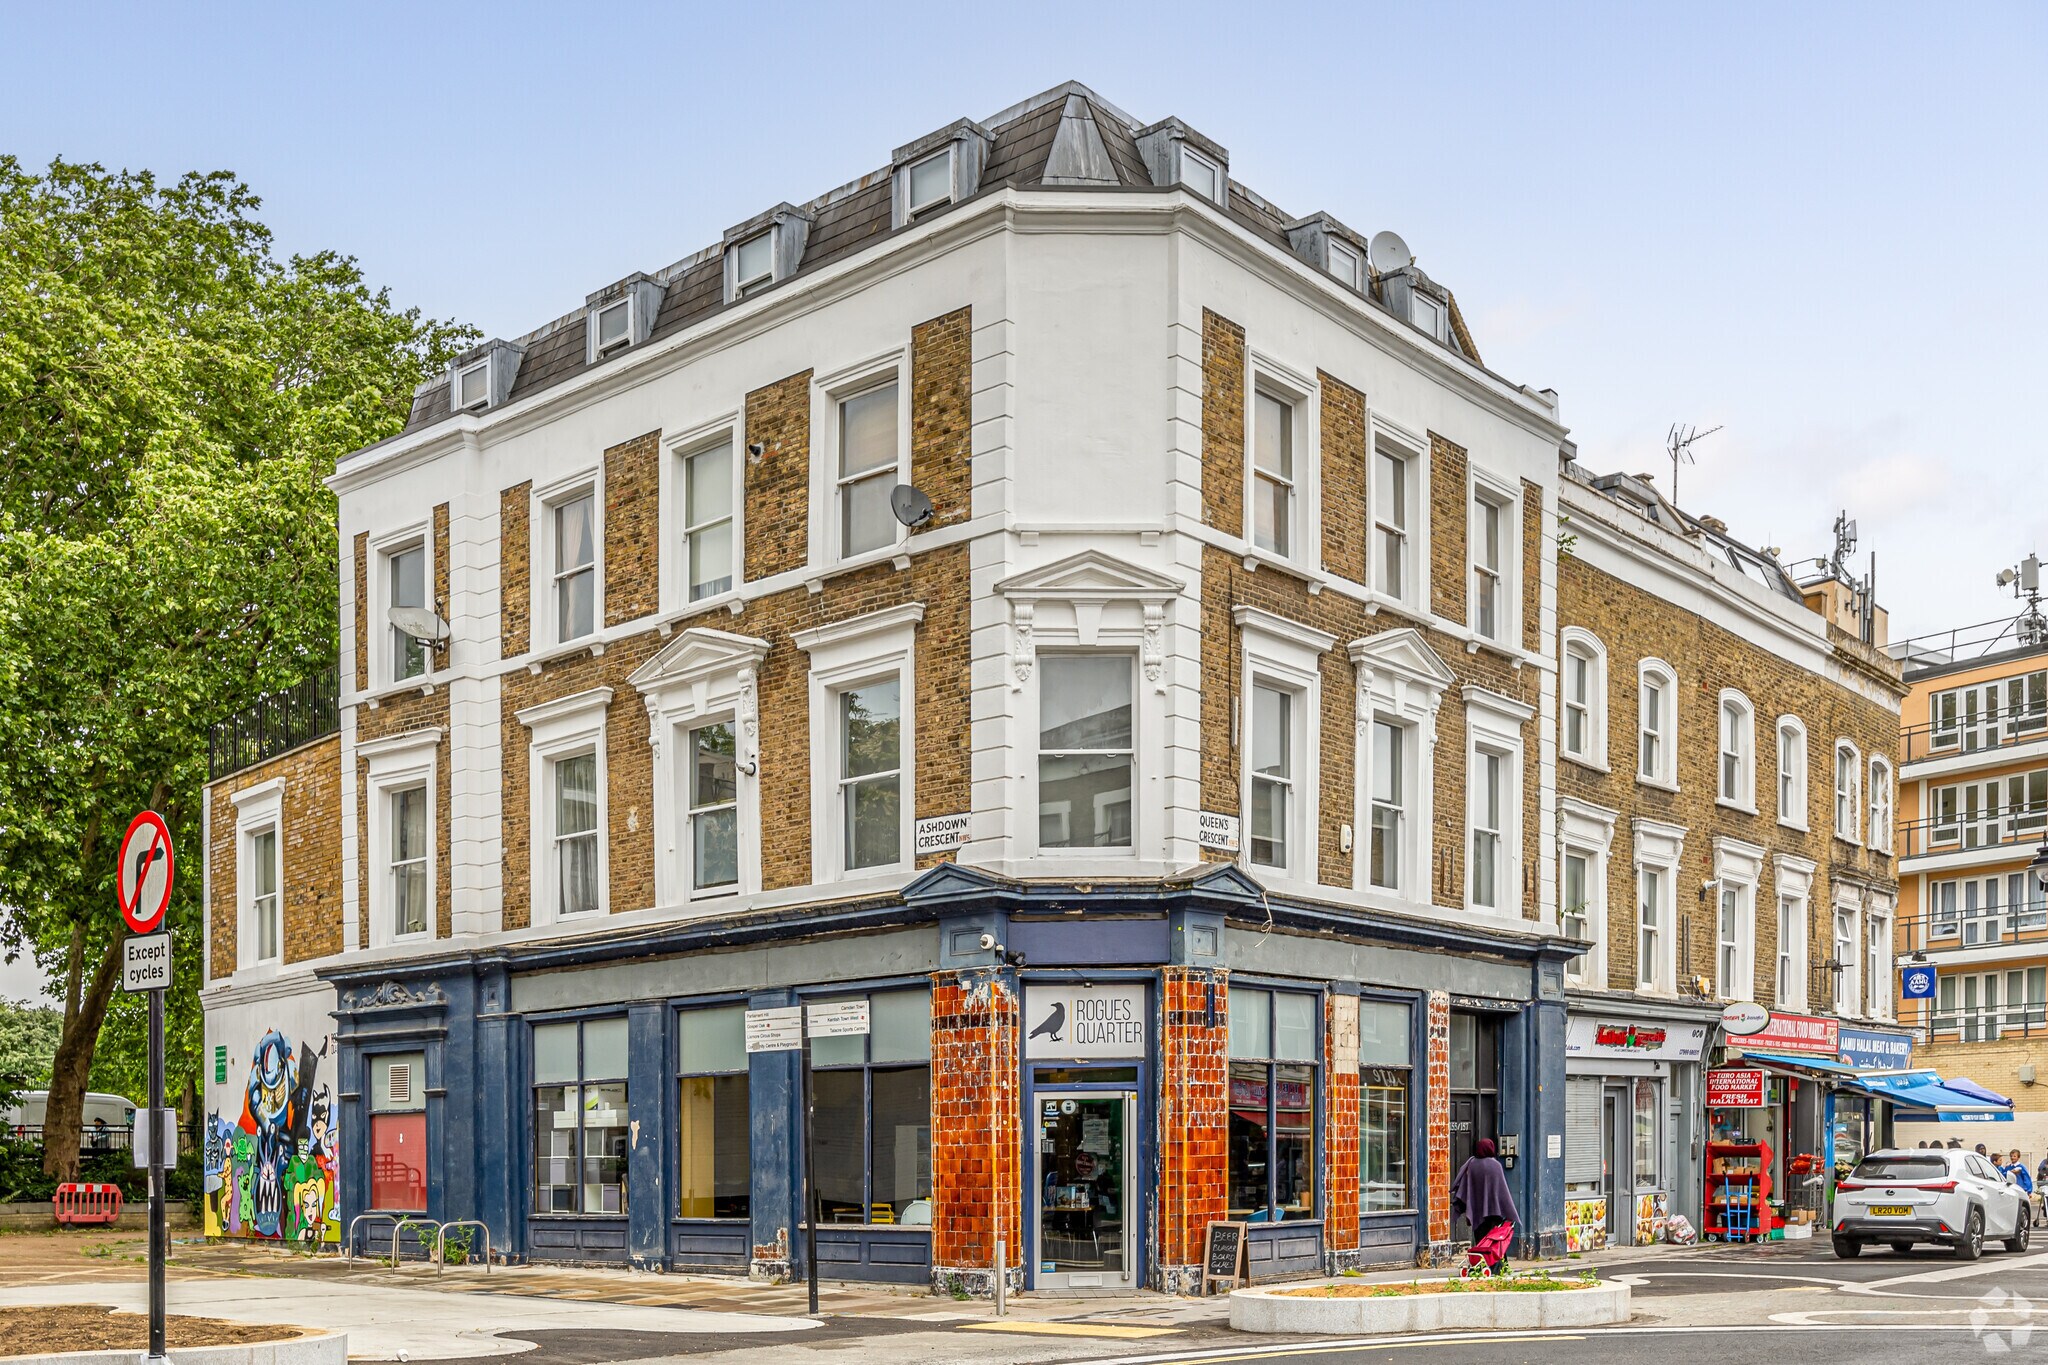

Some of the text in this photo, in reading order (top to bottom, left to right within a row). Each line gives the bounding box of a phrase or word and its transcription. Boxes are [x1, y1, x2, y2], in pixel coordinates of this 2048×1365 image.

[919, 817, 967, 835] ASHDOWN
[1200, 814, 1229, 830] QUEEN'S
[918, 832, 960, 848] CRESCENT
[1199, 830, 1229, 846] CRESCENT
[128, 942, 166, 962] Except
[130, 964, 164, 984] cycles
[1076, 999, 1131, 1021] ROGUES
[1076, 1022, 1142, 1044] QUARTER
[1840, 1036, 1908, 1055] AAMU HALAL MEAT & BAKERY
[1872, 1206, 1892, 1215] LR20
[1213, 1231, 1238, 1242] BEER
[1212, 1252, 1236, 1261] BOARD
[1210, 1261, 1235, 1269] GAMES
